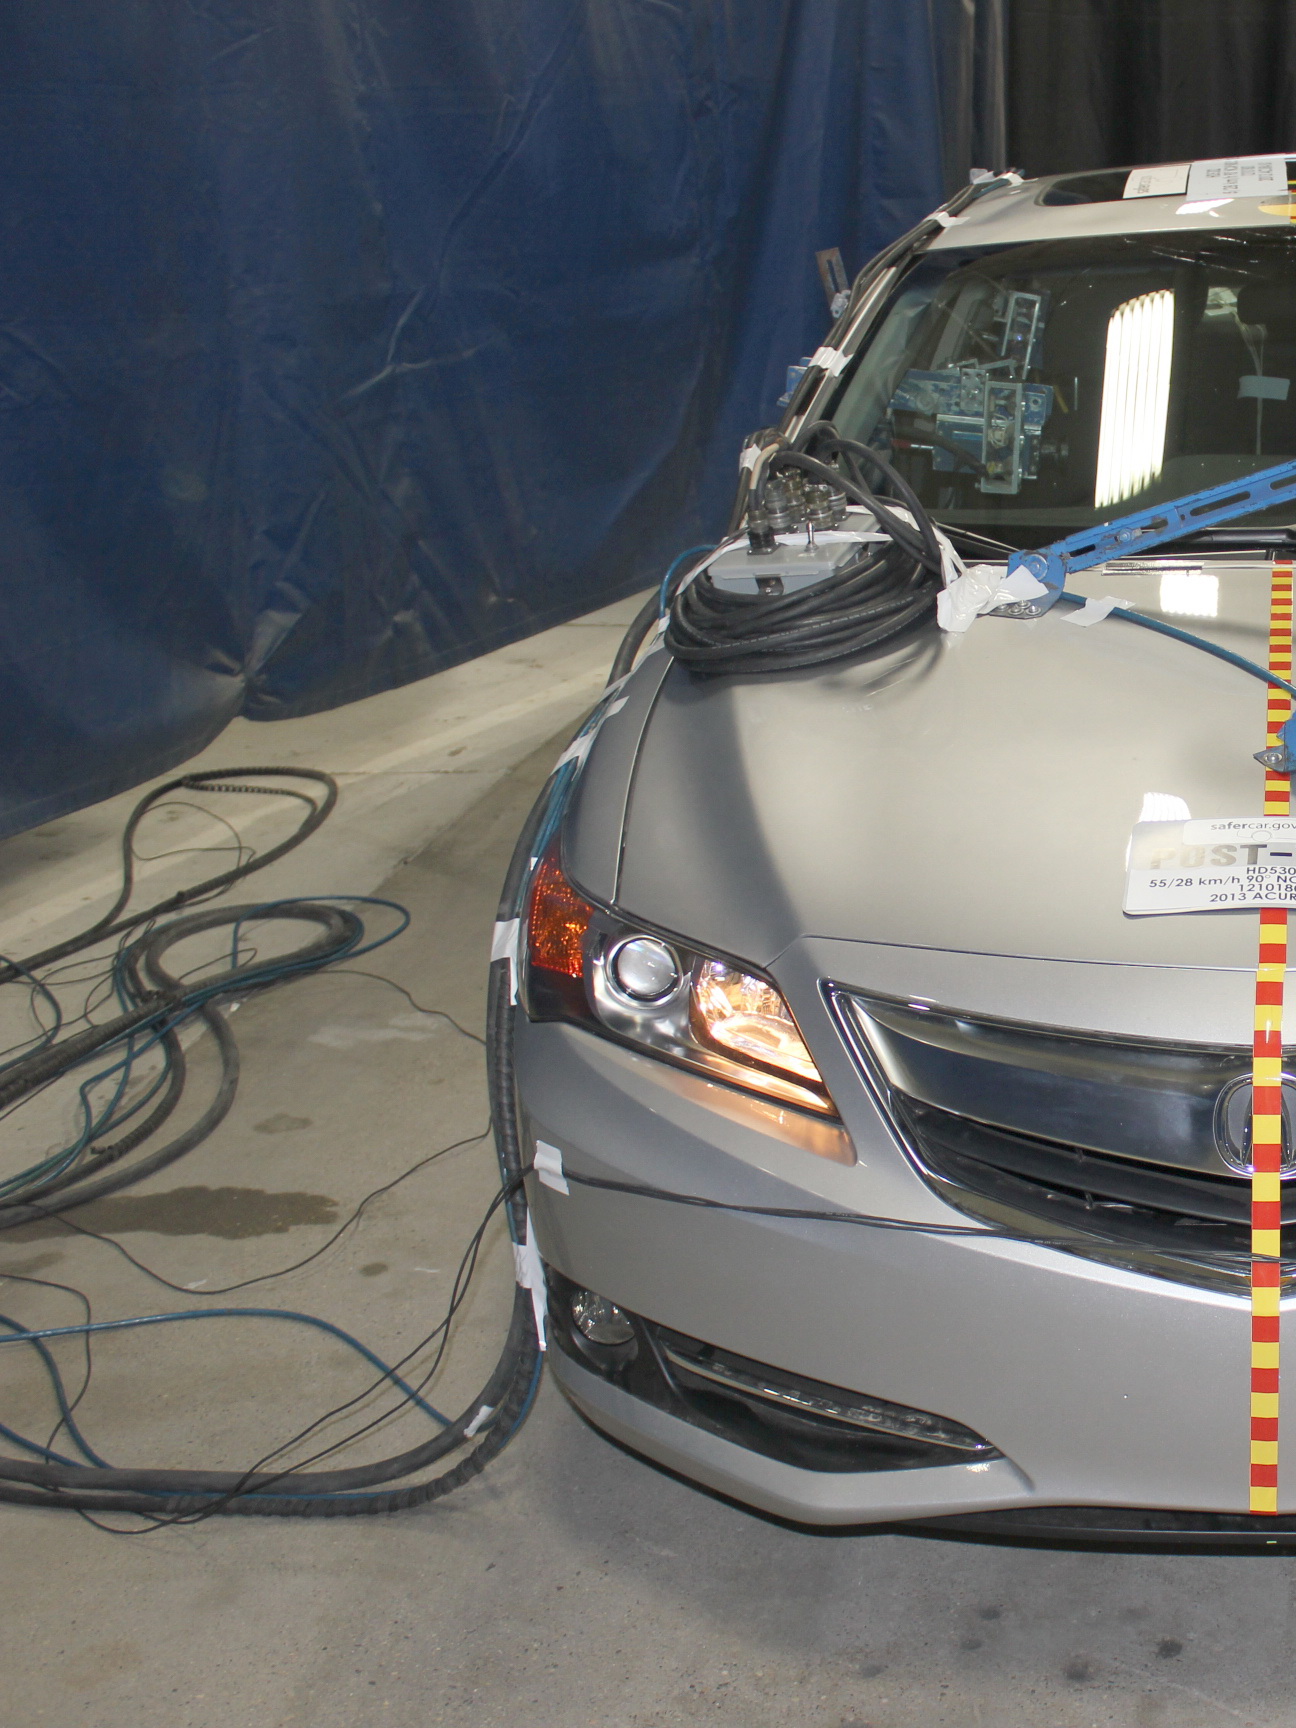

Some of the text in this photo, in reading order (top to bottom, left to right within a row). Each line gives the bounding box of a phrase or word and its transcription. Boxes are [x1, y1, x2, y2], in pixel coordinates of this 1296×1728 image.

[1149, 877, 1193, 888] 55/28
[1199, 875, 1240, 886] km/h
[1209, 893, 1247, 902] 2013
